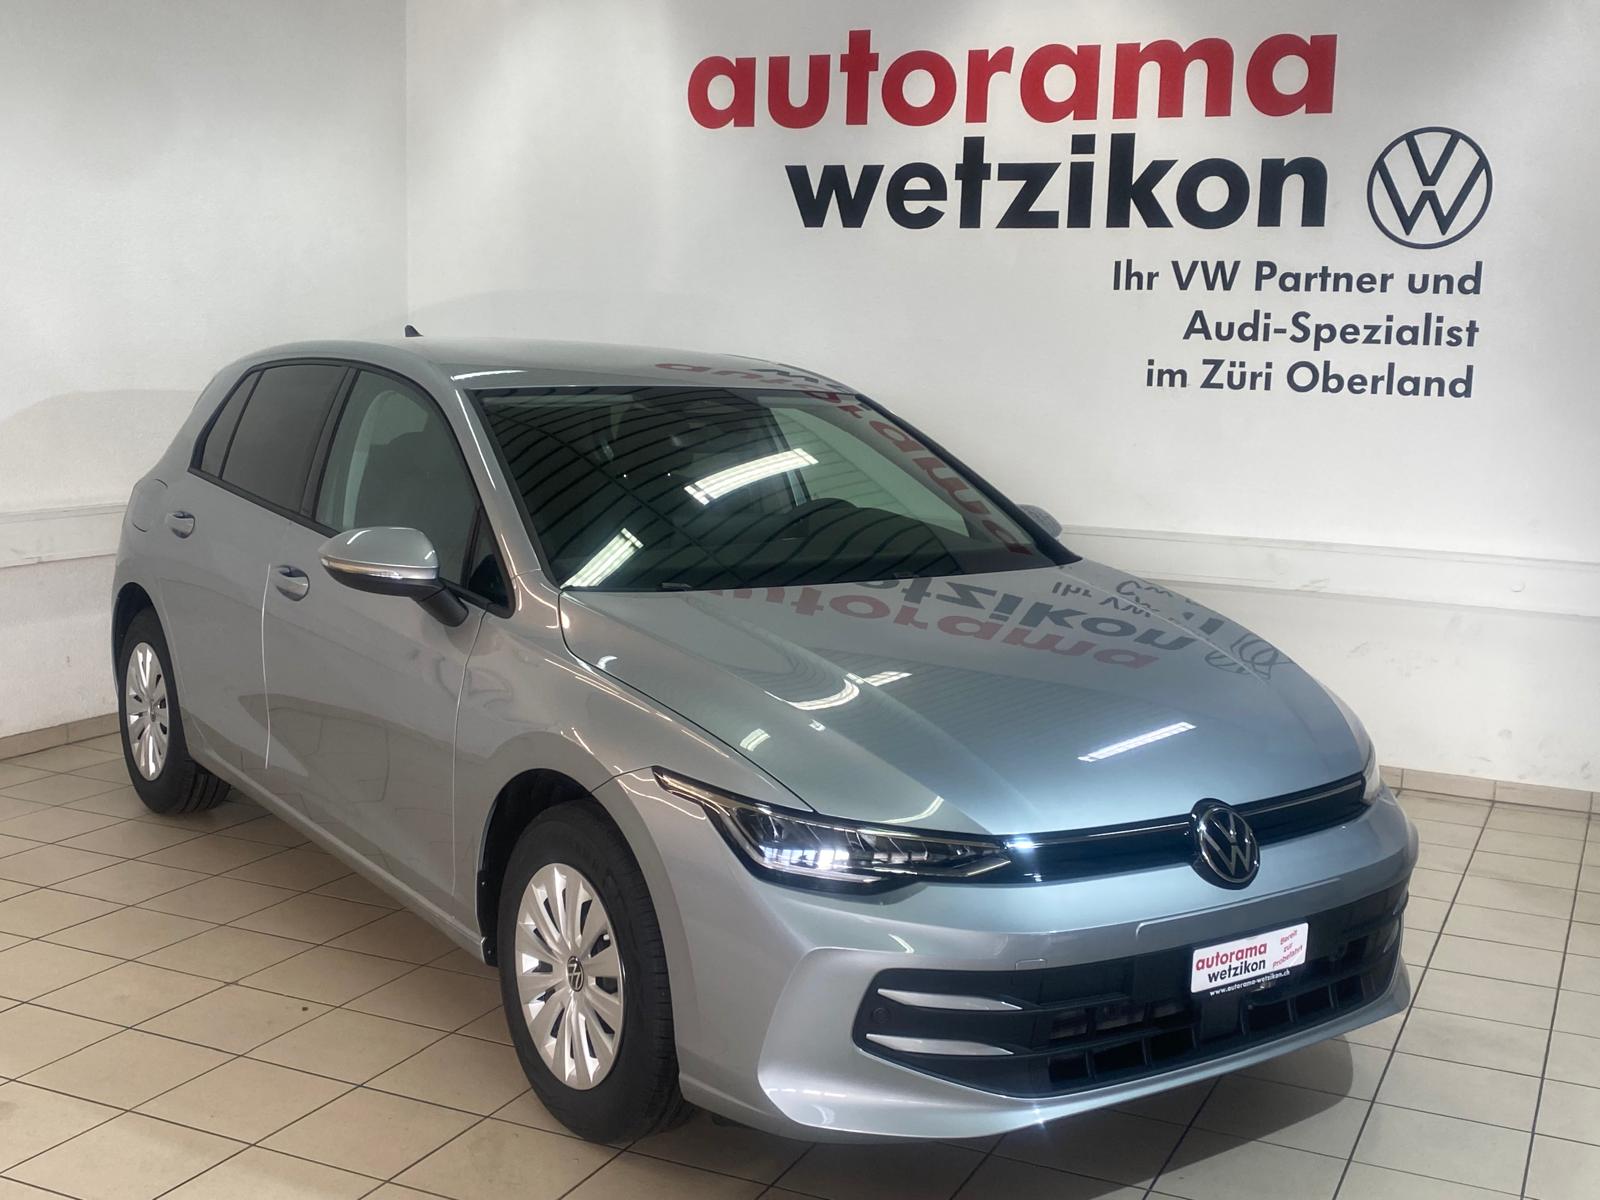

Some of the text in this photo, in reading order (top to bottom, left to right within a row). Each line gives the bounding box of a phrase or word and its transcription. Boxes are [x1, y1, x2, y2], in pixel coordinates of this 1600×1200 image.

[688, 30, 1337, 129] autorama
[785, 133, 1327, 229] wetzikon
[1114, 260, 1482, 295] Ihr VW Partner und
[1183, 310, 1480, 351] Audi-Spezialist
[1146, 358, 1474, 397] im Züri Oberland
[1196, 943, 1267, 971] autorama
[1273, 945, 1303, 968] Probefahrt
[1283, 943, 1294, 952] zur
[1207, 959, 1266, 983] wetzikon
[1210, 969, 1290, 996] www.autorama-wetzikon.ch
